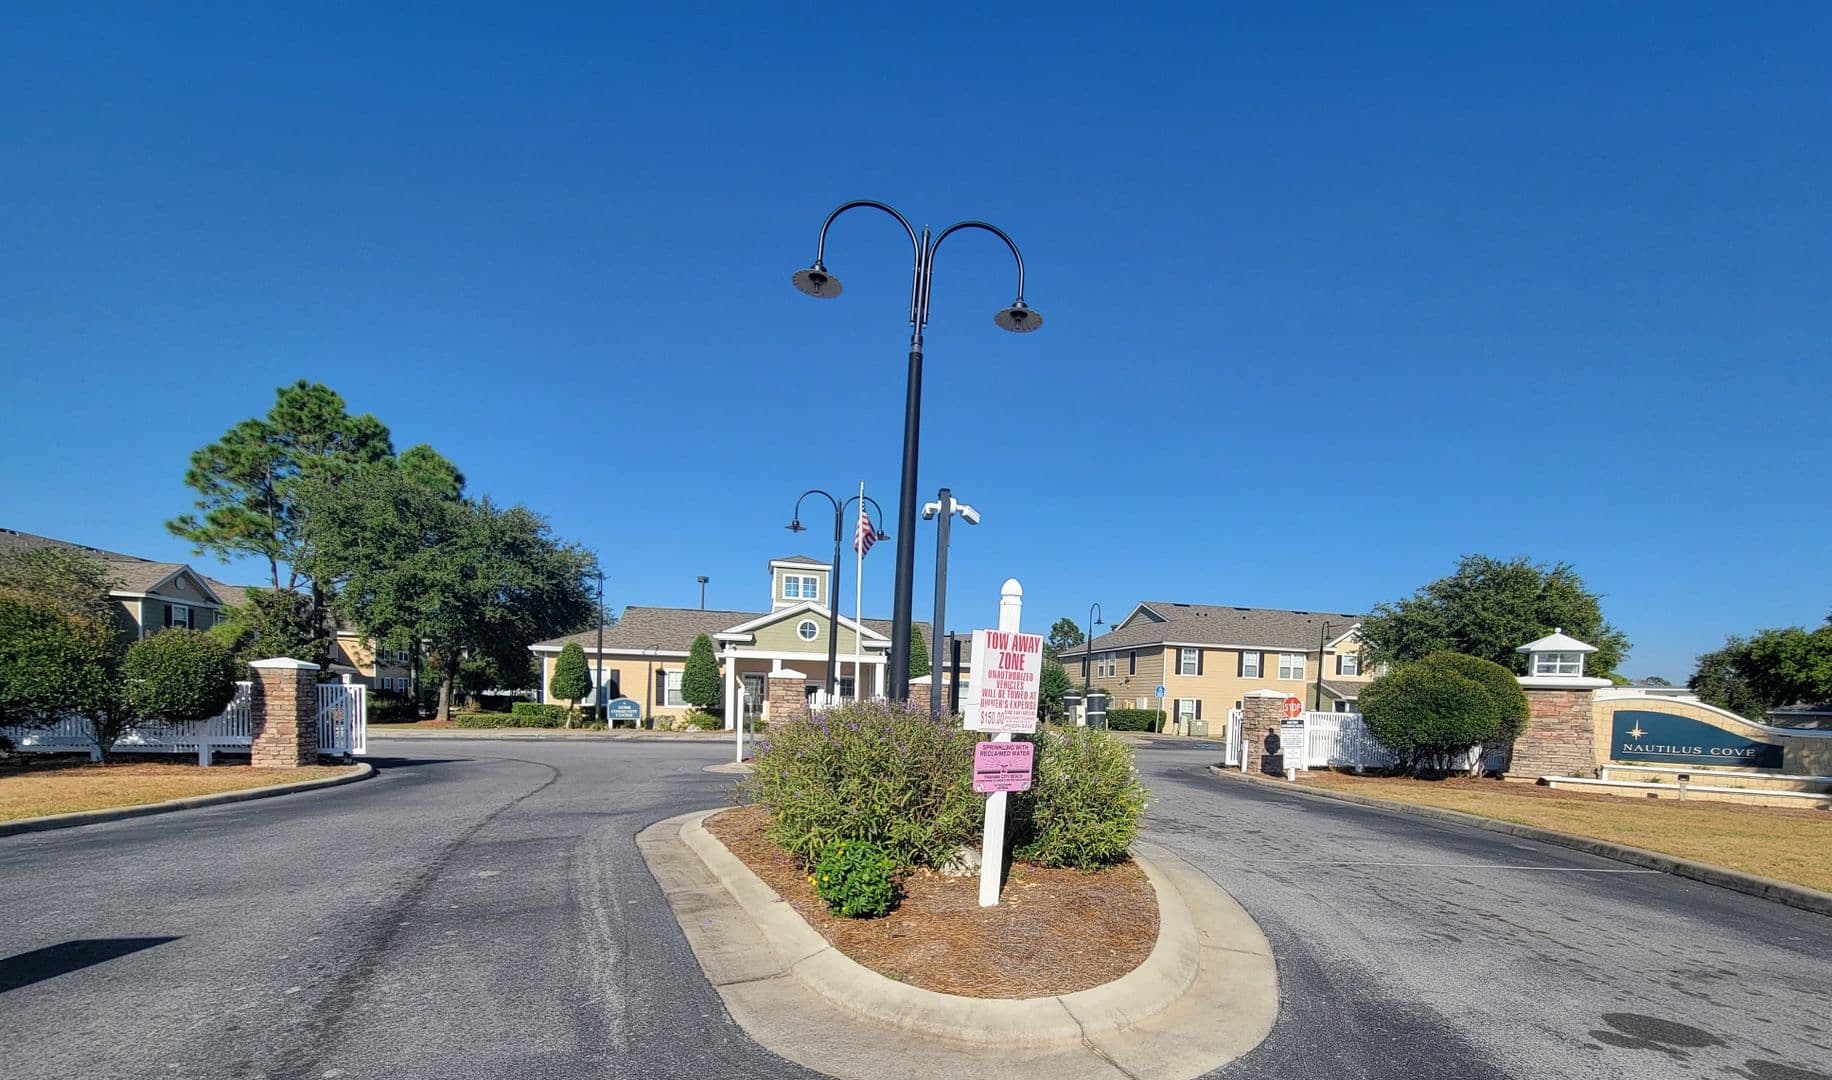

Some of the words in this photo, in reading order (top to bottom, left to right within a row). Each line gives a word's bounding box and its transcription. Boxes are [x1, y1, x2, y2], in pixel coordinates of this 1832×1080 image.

[986, 631, 1009, 651] TOW
[1012, 633, 1041, 653] AWAY
[998, 652, 1025, 671] ZONE
[988, 669, 1034, 682] UNAUTHORIZED
[996, 680, 1024, 690] VEHICLES
[982, 688, 996, 698] WILL
[998, 689, 1005, 699] BE
[1007, 690, 1029, 700] TOWED
[1030, 691, 1037, 700] AT
[980, 698, 1009, 709] OWNER'S
[1010, 700, 1036, 710] EXPENSE
[1284, 703, 1301, 712] STOP
[1623, 743, 1702, 755] NAUTILUS
[1710, 747, 1756, 757] COVE
